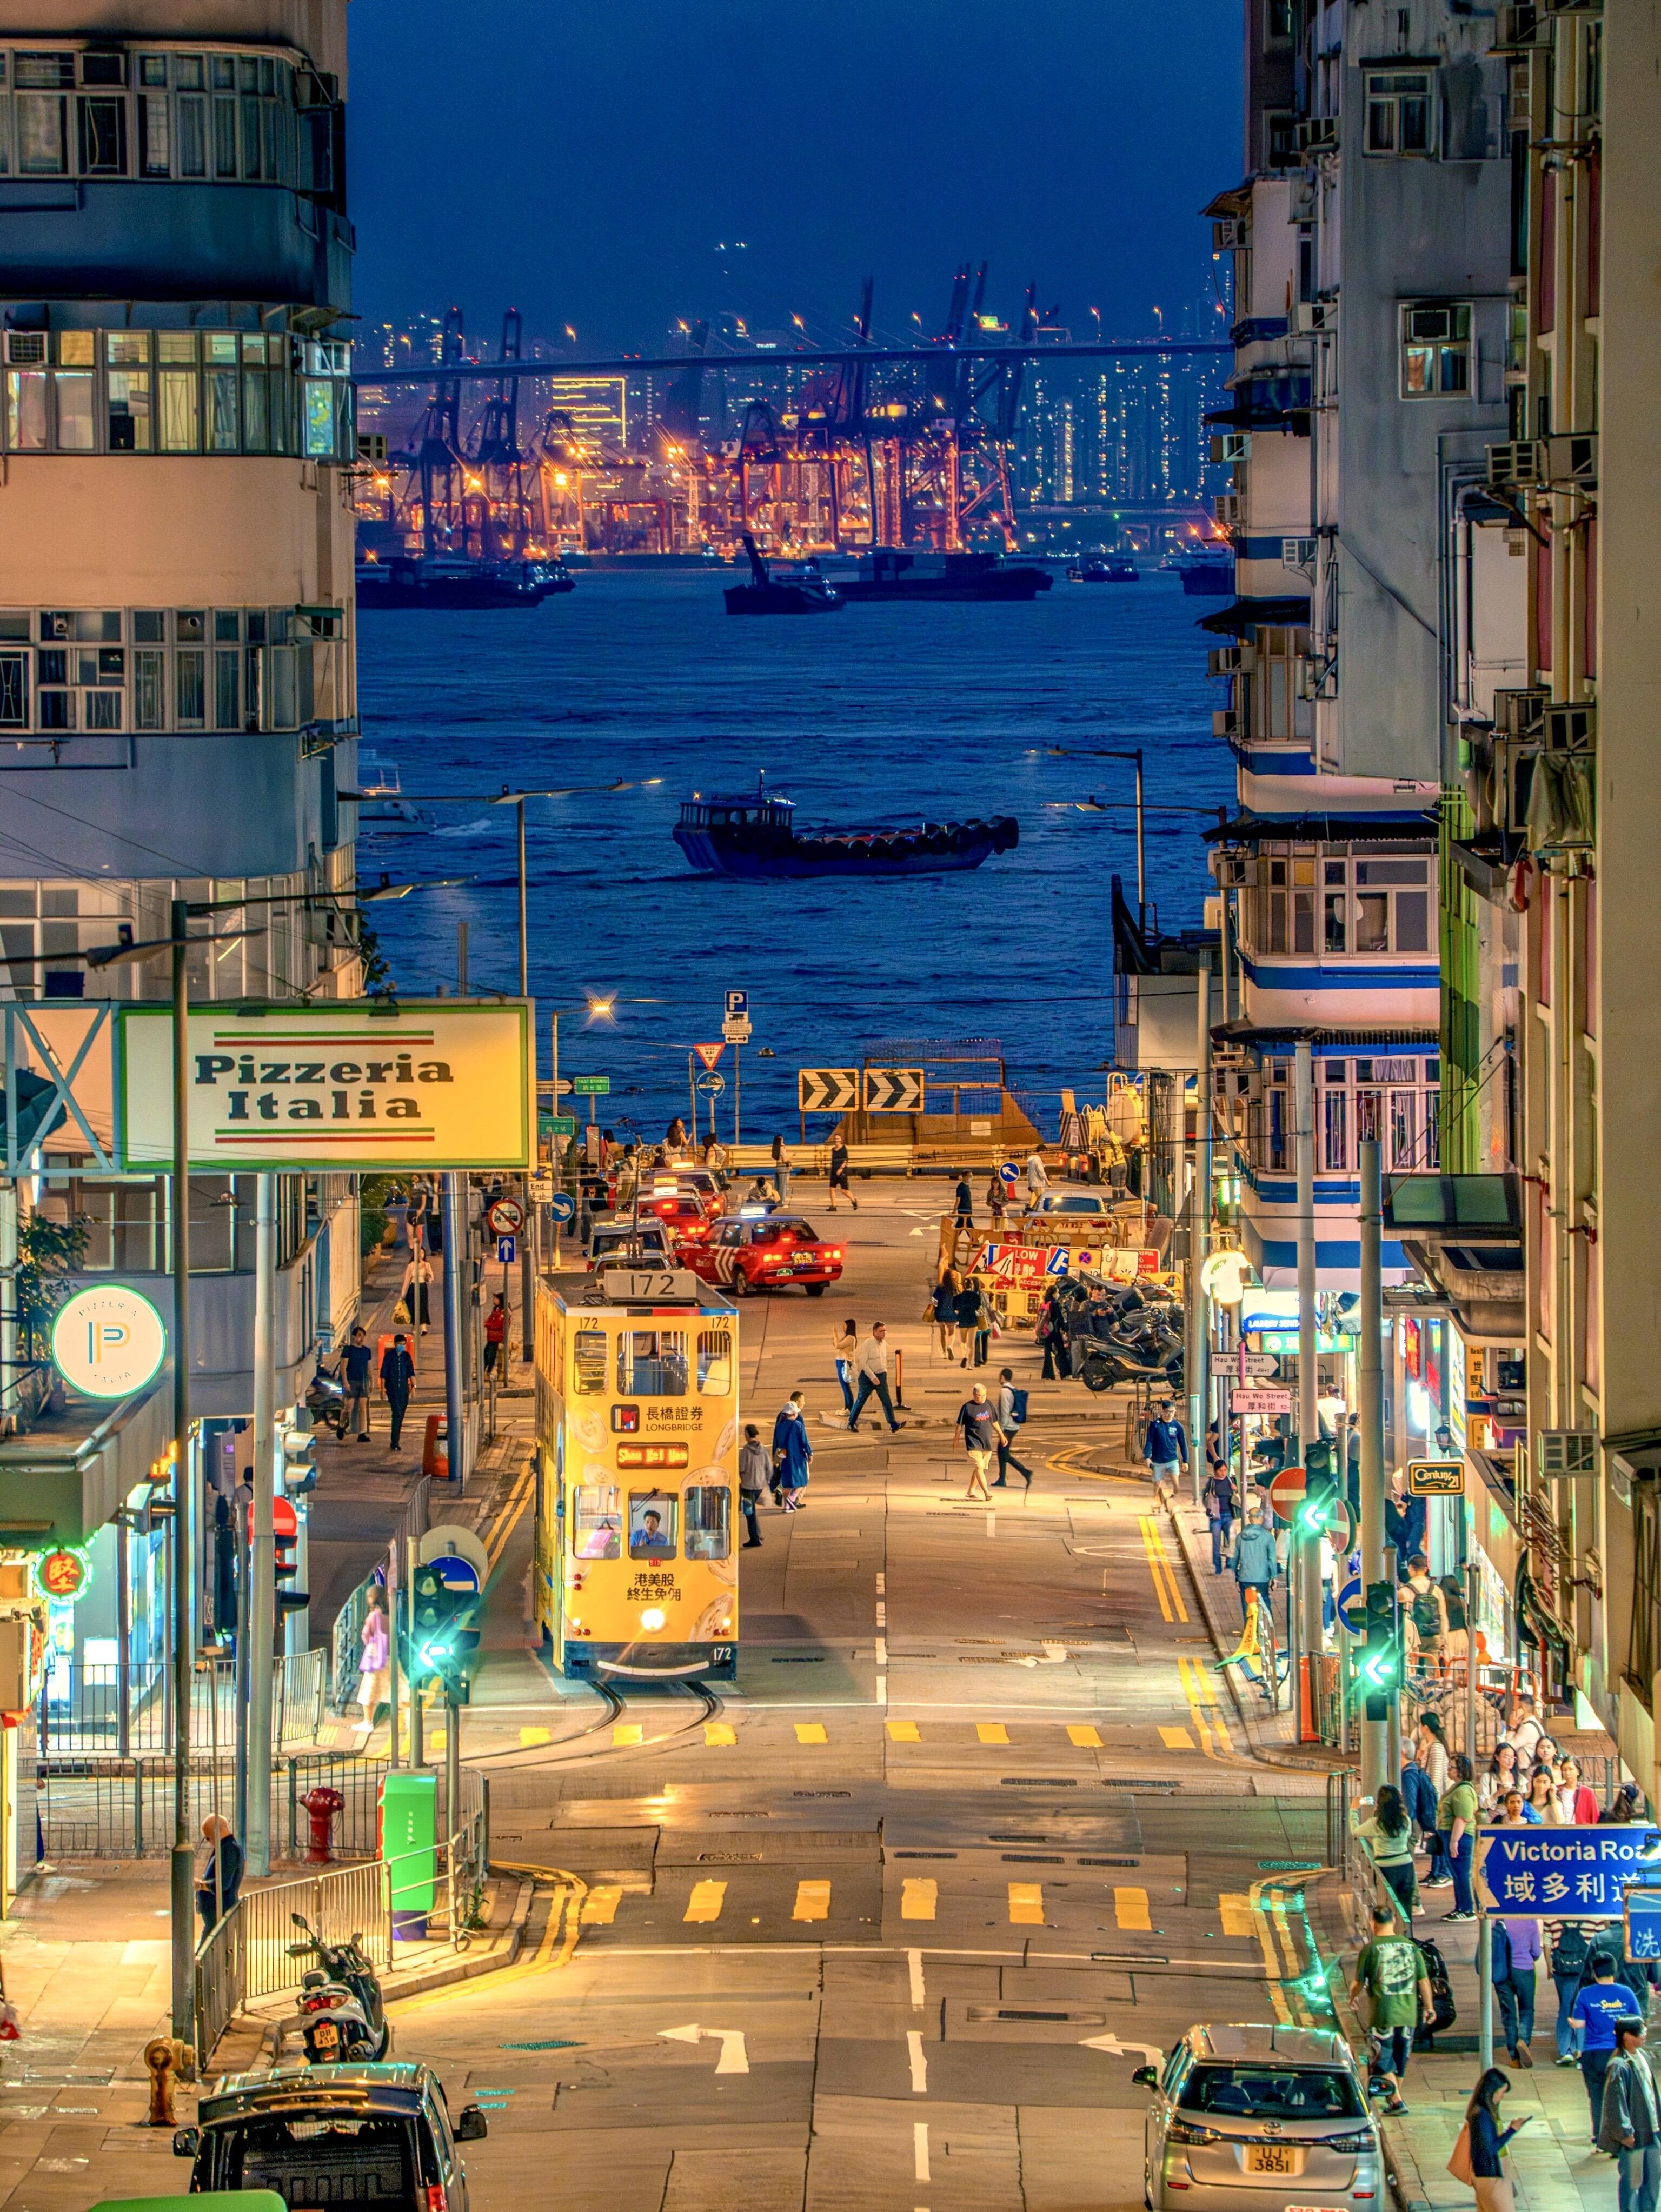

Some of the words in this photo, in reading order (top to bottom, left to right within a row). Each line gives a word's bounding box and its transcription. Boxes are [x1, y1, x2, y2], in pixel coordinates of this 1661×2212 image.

[729, 992, 744, 1011] P
[195, 1053, 454, 1084] Pizzeria
[228, 1090, 421, 1120] Italia
[1008, 1249, 1038, 1261] LOW
[630, 1274, 675, 1295] 172
[79, 1301, 137, 1317] PIZZERIA
[580, 1317, 598, 1329] 172
[712, 1316, 729, 1328] 172
[1247, 1402, 1276, 1410] 厚和街
[646, 1406, 703, 1421] 長橋證券
[646, 1423, 703, 1431] LONGBRIDGE
[1415, 1468, 1452, 1481] Century
[1447, 1475, 1459, 1488] 21
[634, 1573, 675, 1587] 港美股
[627, 1587, 681, 1601] 終生免佣
[714, 1647, 732, 1661] 172
[1502, 1841, 1596, 1861] Victoria
[1600, 1840, 1661, 1861] Roa
[1635, 1928, 1661, 1958] 洗
[1262, 2147, 1282, 2160] UJ
[1254, 2159, 1290, 2173] 3851
